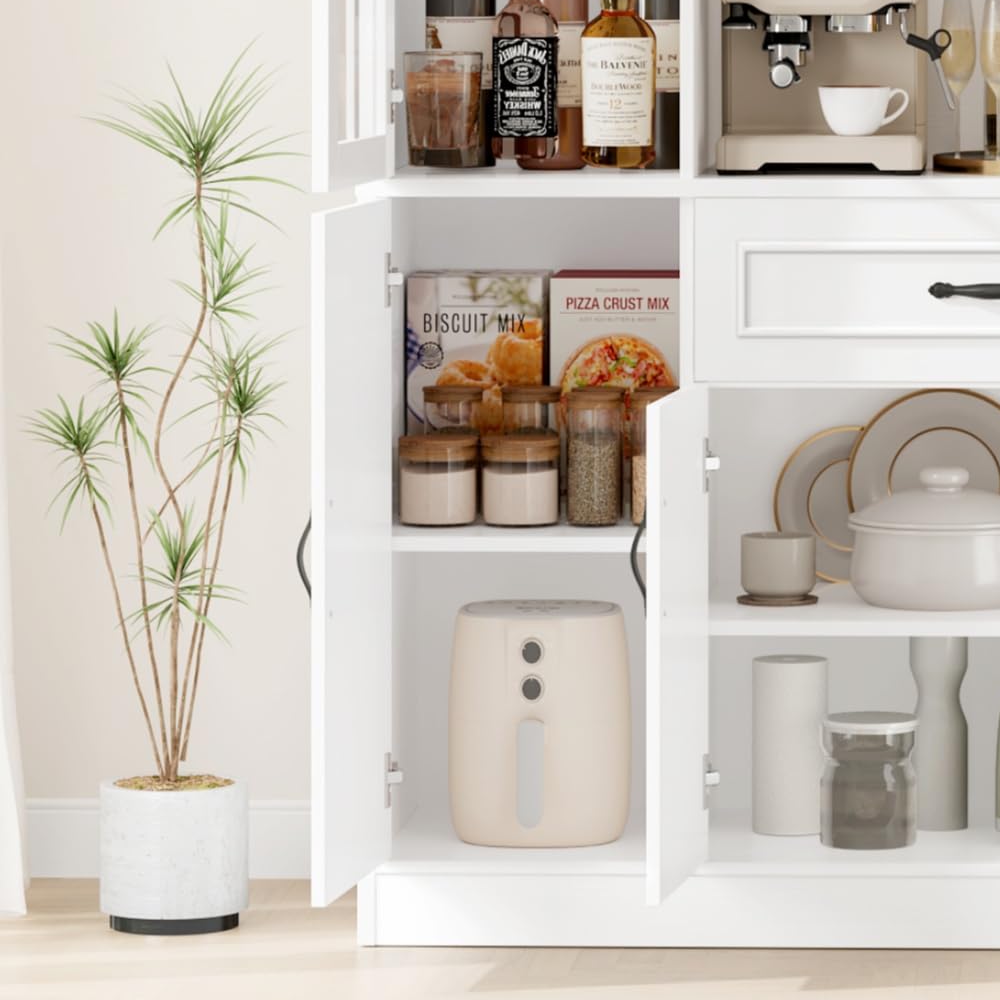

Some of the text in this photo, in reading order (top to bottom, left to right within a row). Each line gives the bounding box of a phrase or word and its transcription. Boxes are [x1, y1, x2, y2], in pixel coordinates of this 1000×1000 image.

[566, 297, 670, 311] PIZZA CRUST MIX
[423, 313, 526, 333] BISCUIT MIX
